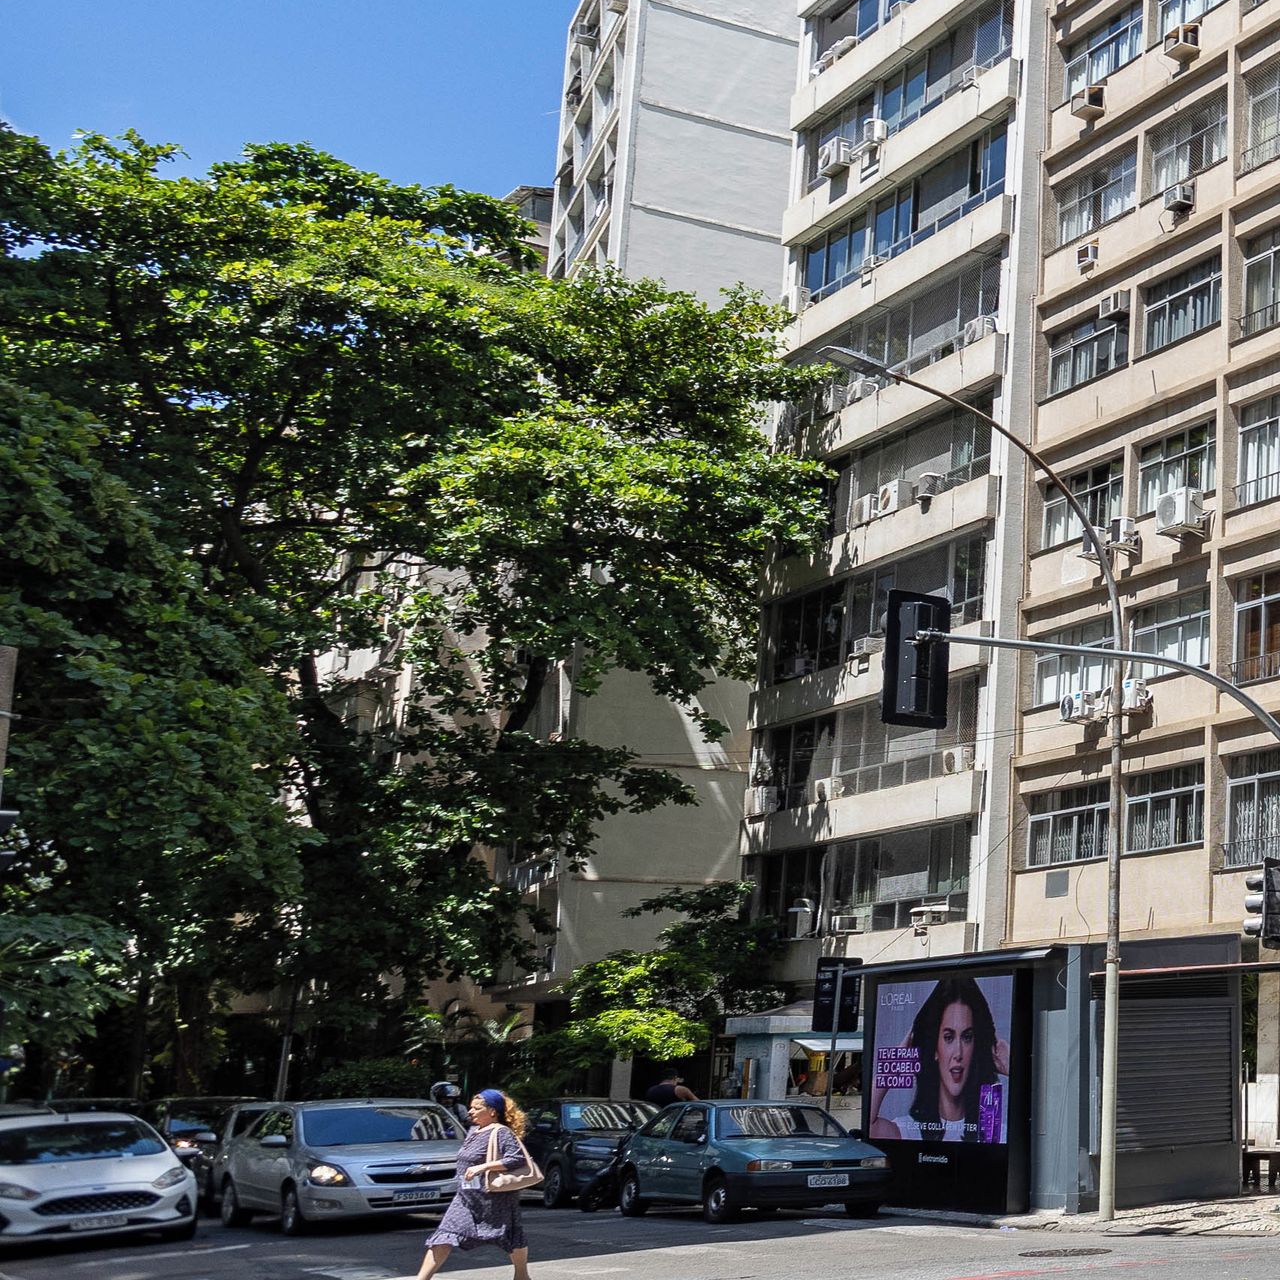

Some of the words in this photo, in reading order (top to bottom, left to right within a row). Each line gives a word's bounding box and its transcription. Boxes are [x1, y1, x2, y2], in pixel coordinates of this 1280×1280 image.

[878, 1048, 896, 1059] TEVE
[897, 1048, 919, 1059] PRAIA
[877, 1062, 883, 1073] E
[883, 1062, 890, 1073] O
[890, 1062, 921, 1073] CABELO
[887, 1076, 912, 1087] COMO
